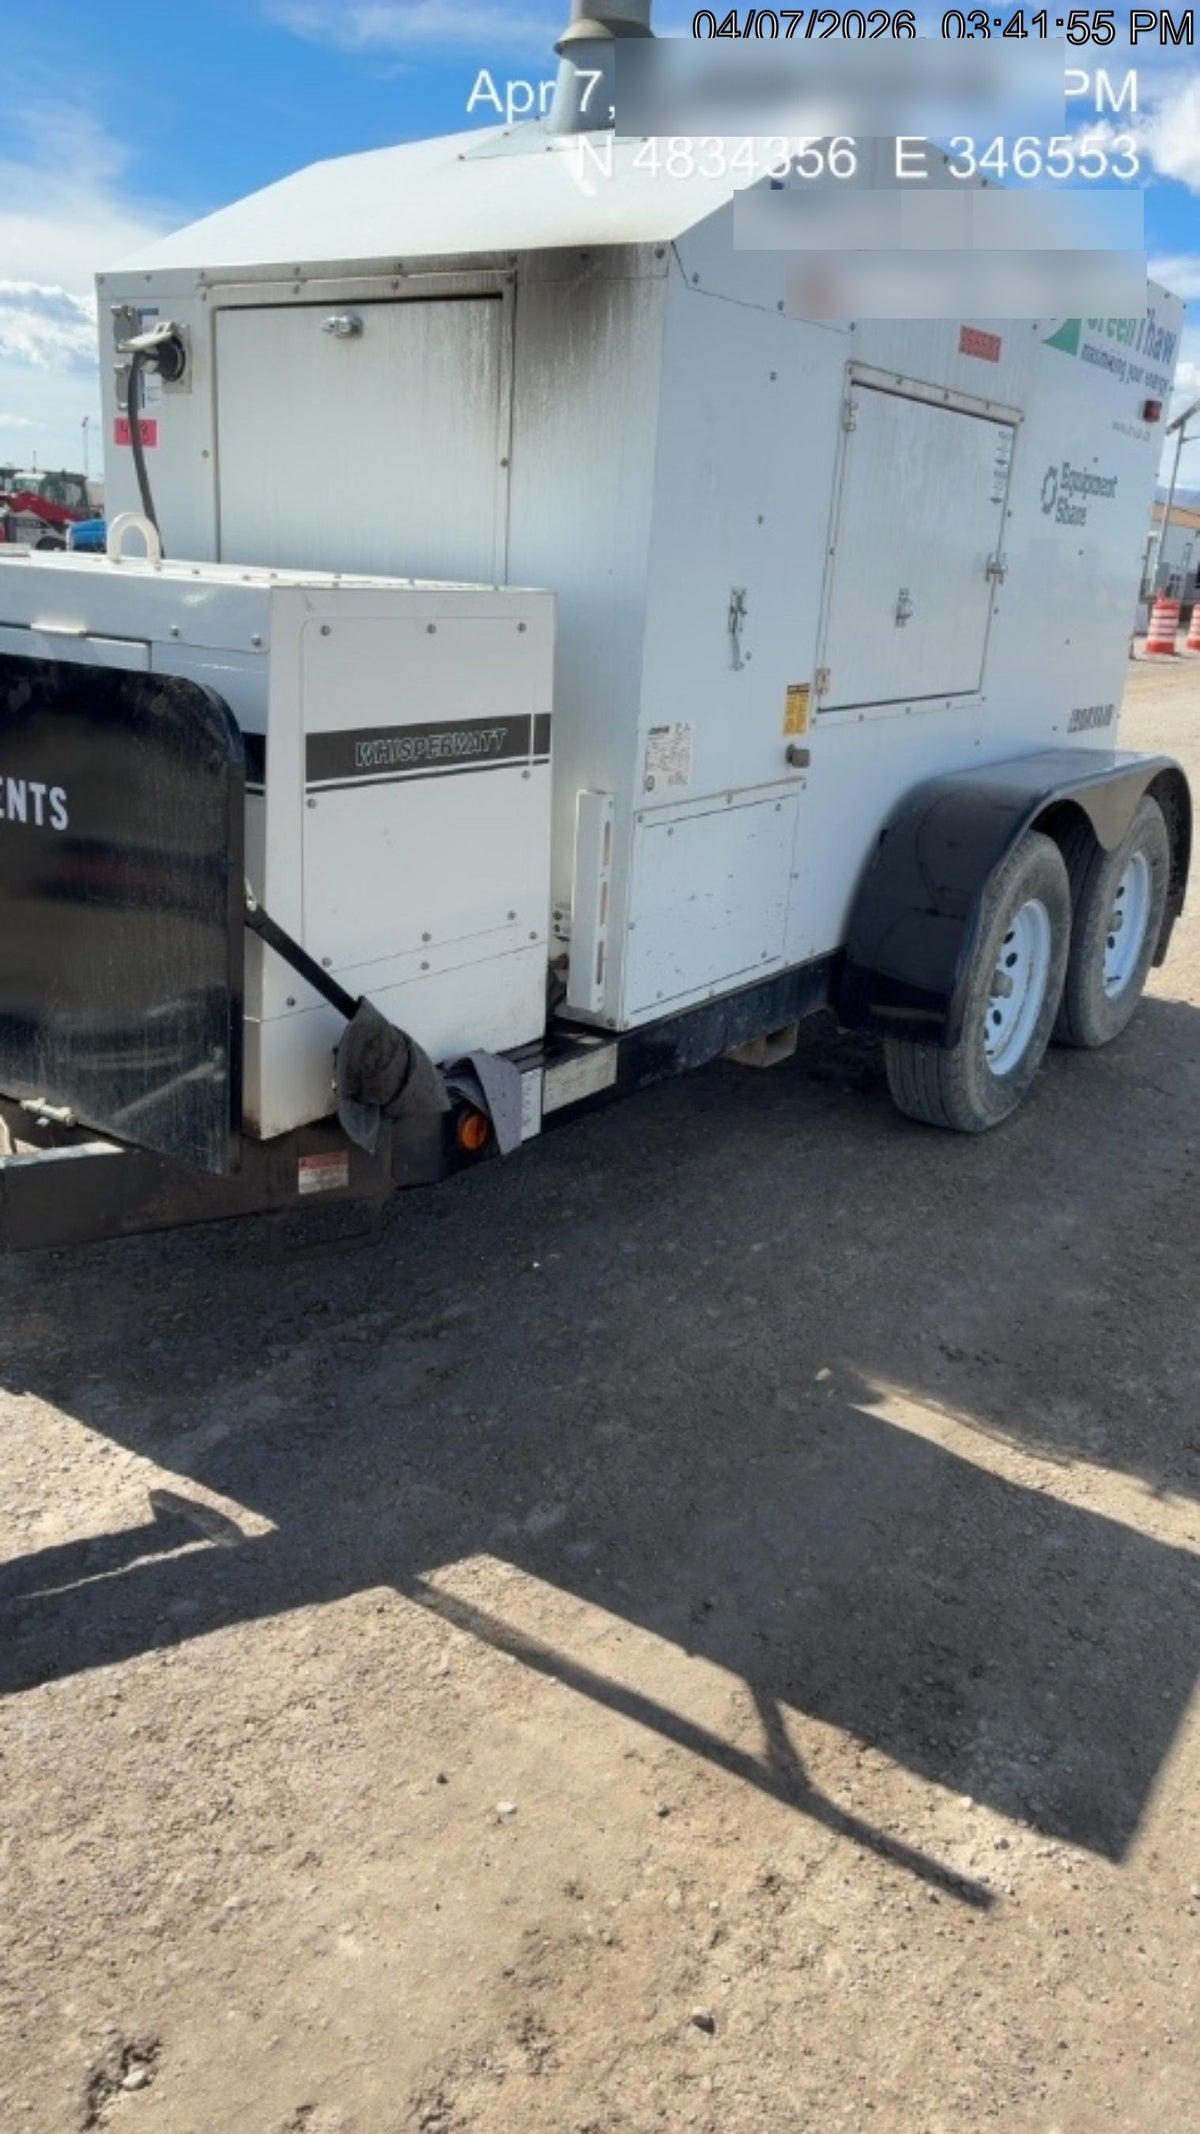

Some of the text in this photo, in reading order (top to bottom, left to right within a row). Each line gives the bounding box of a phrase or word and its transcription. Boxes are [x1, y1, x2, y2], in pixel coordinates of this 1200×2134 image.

[1060, 462, 1118, 500] Equipment
[1055, 496, 1088, 527] Share
[355, 727, 508, 767] WHISPERWATT
